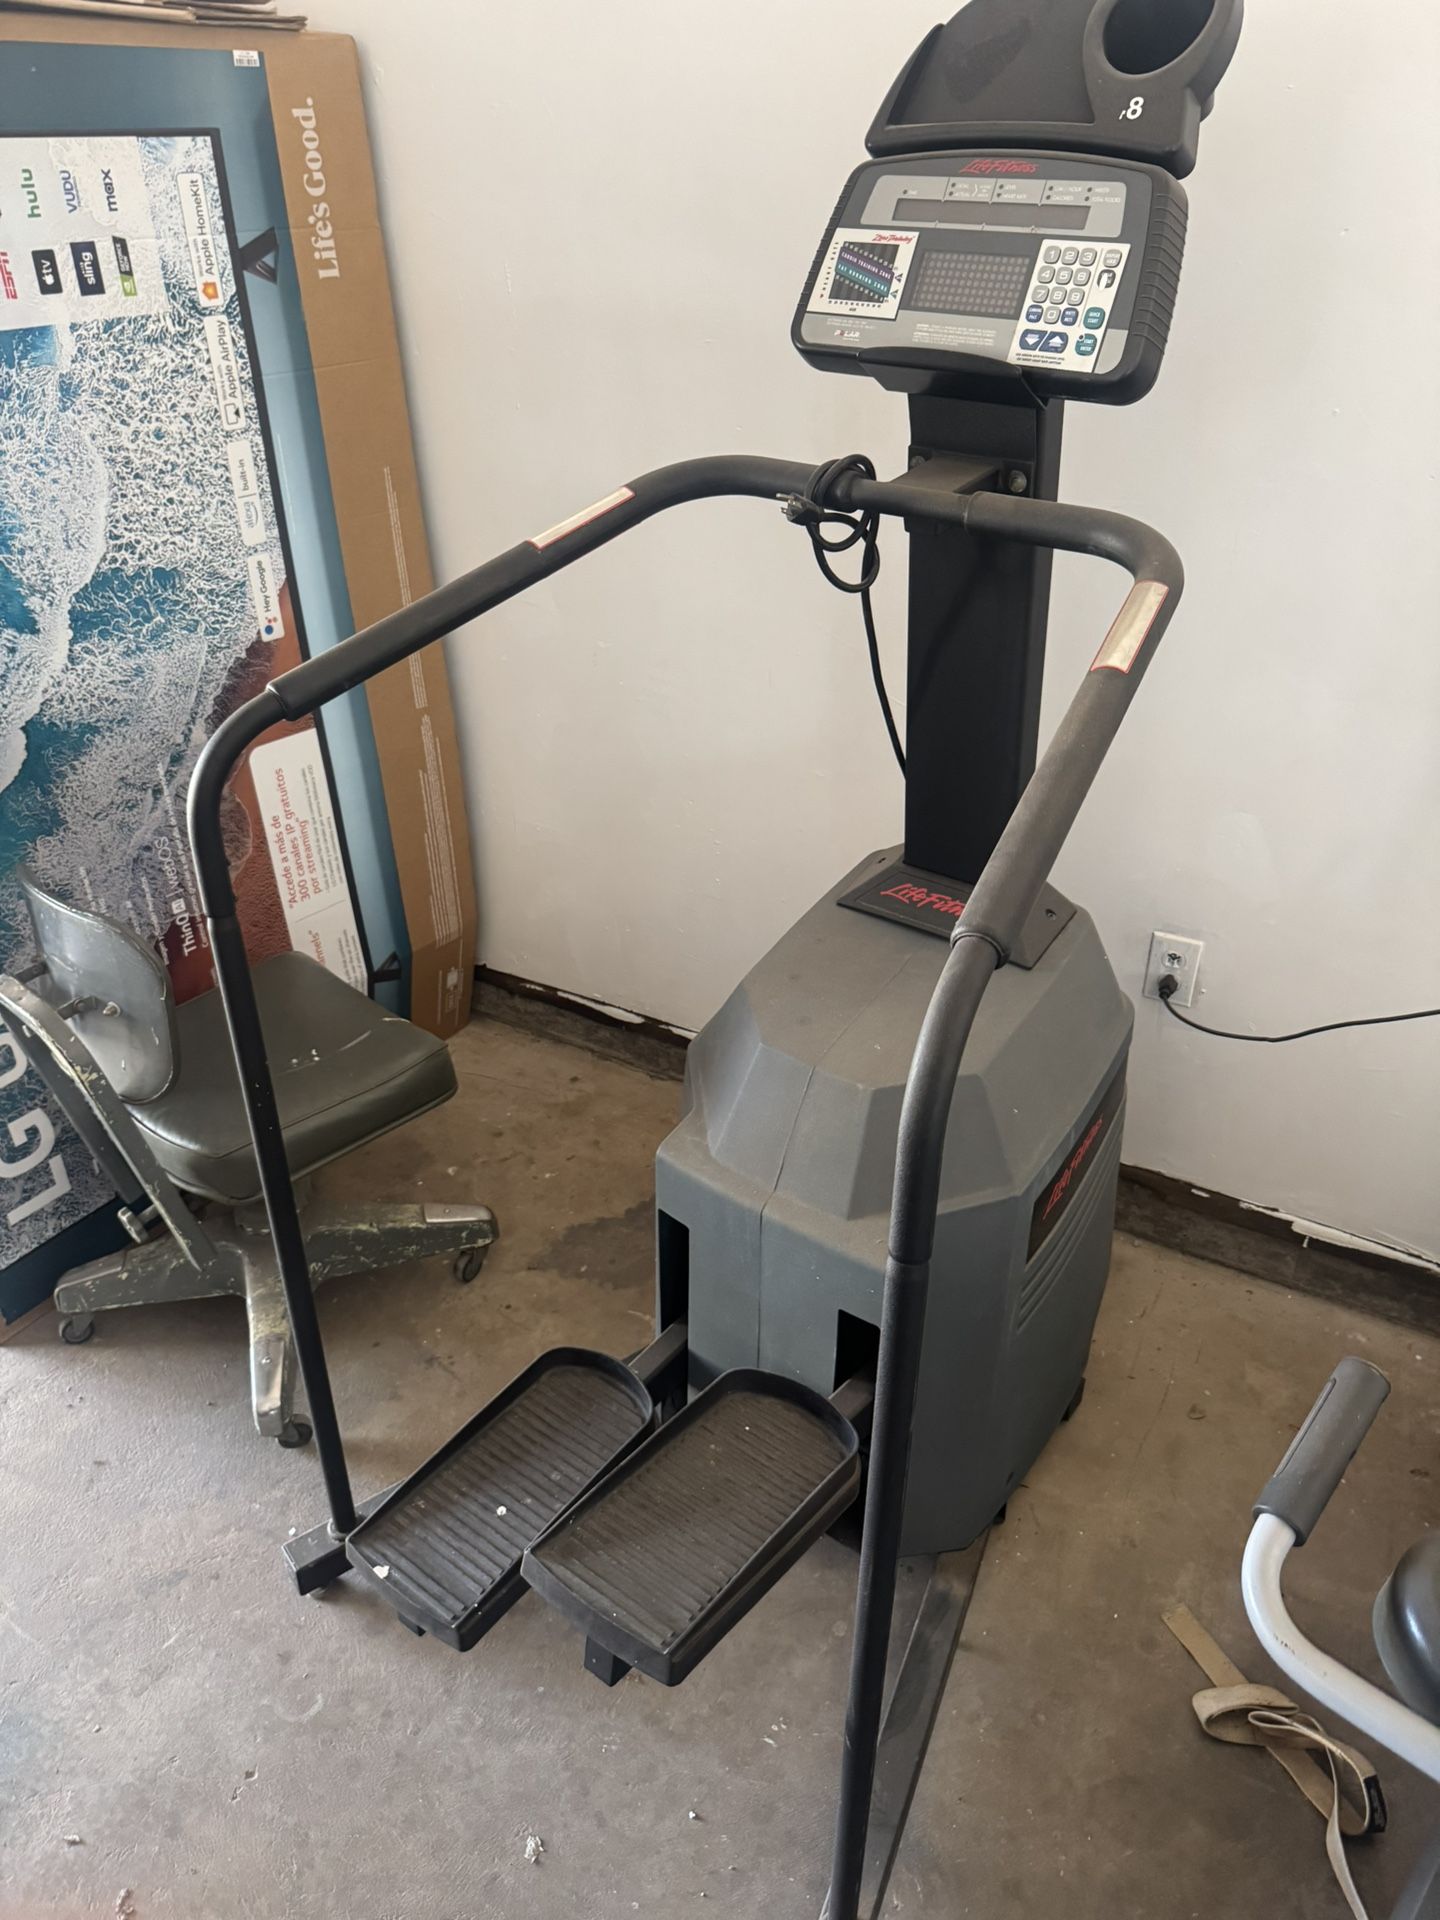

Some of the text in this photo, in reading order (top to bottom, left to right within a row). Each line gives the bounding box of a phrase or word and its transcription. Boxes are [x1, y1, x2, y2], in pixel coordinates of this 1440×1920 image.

[21, 168, 42, 218] hulu
[60, 170, 77, 213] VUDU
[101, 168, 118, 212] max
[291, 97, 340, 279] Life's Good.
[190, 179, 215, 275] Apple HomeKit
[82, 252, 96, 285] sling
[217, 320, 238, 399] Apple AirPlay
[238, 458, 250, 491] built-in
[256, 560, 272, 612] Hey Google
[270, 815, 282, 830] de
[275, 834, 288, 854] más
[276, 767, 311, 902] 300 canales IP gratuitos
[155, 836, 180, 888] webOS
[311, 875, 322, 894] por
[176, 911, 197, 957] ThinQ
[0, 1107, 72, 1227] LG
